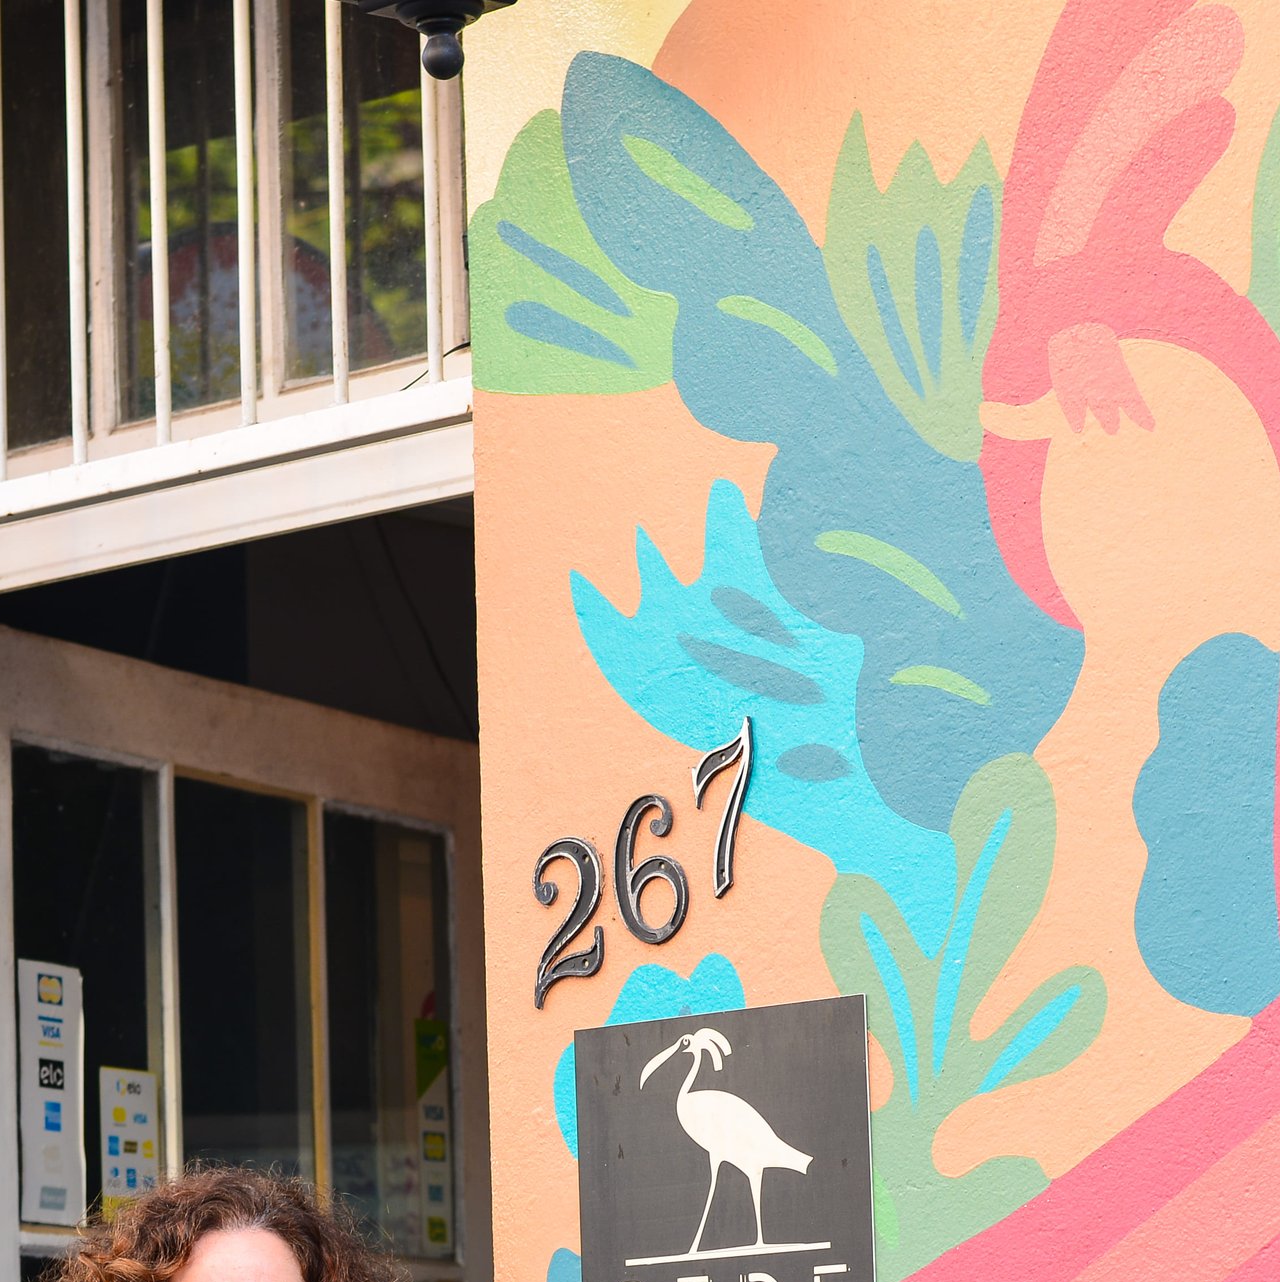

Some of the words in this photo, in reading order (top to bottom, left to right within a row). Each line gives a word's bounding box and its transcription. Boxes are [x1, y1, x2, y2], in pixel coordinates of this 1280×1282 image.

[533, 716, 753, 1009] 267
[41, 1024, 61, 1039] VISA
[133, 1113, 148, 1124] VISA
